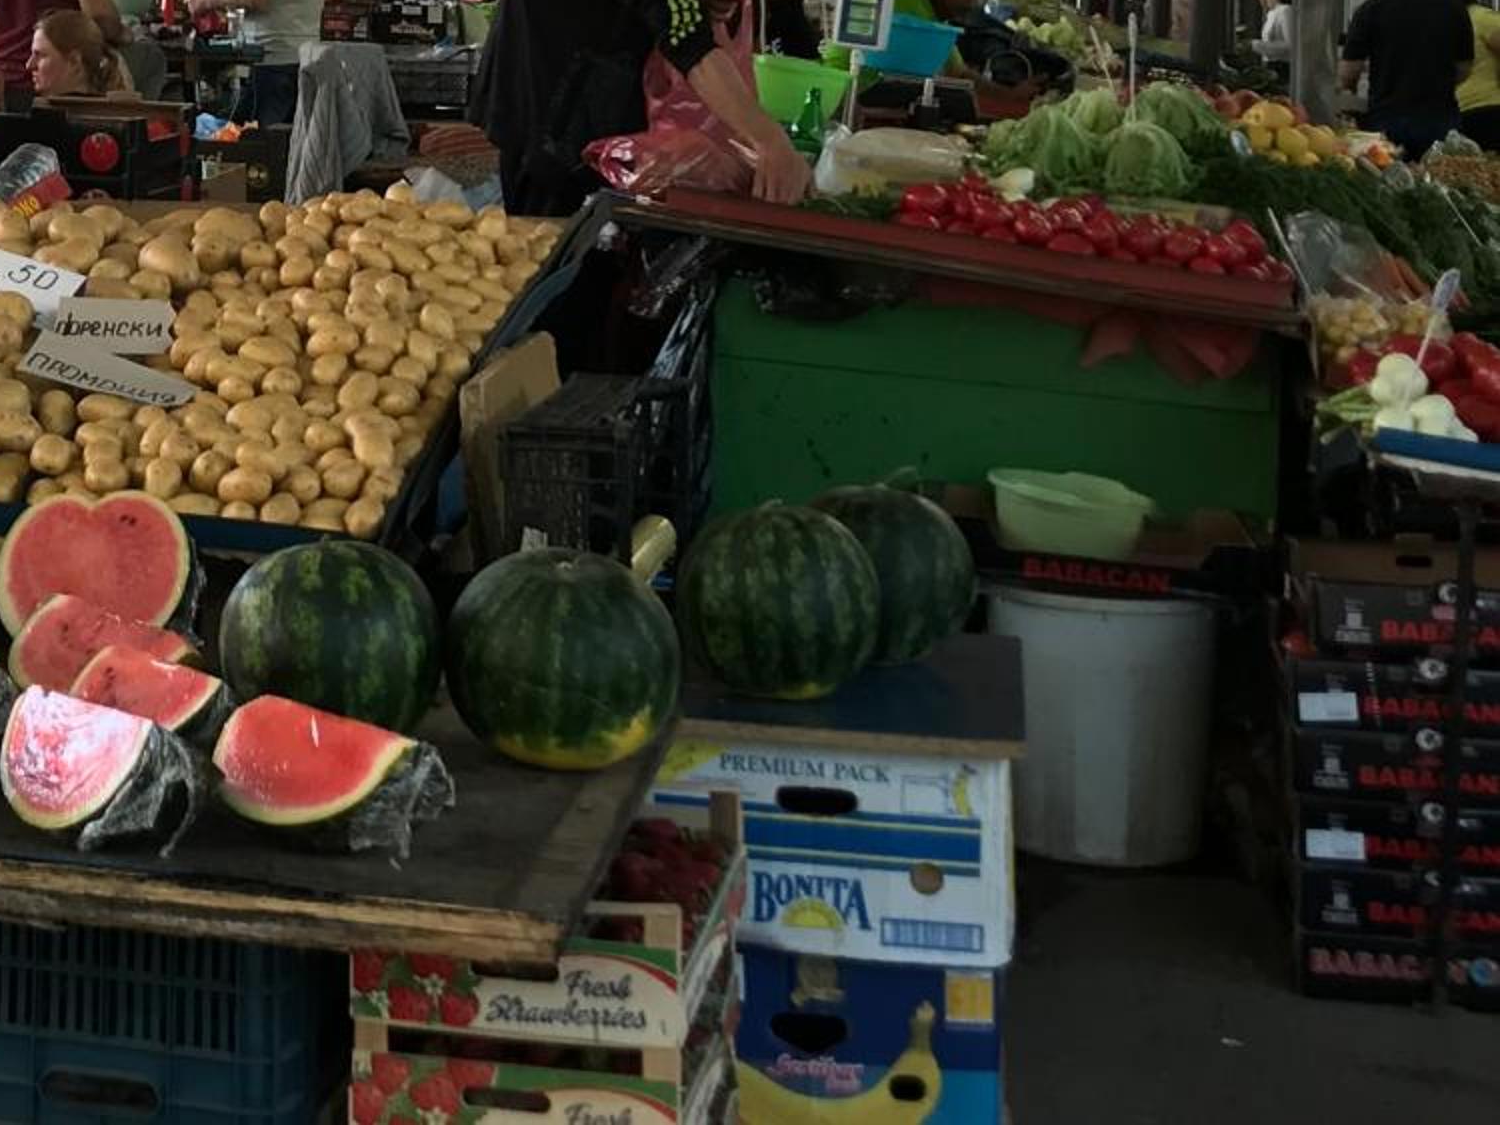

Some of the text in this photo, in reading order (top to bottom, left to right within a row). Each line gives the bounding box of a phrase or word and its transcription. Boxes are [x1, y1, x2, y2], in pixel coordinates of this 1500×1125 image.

[7, 264, 60, 290] 50
[719, 751, 891, 785] PREMIUM PACK
[752, 870, 872, 932] BONITA
[562, 969, 634, 1001] Fresh
[484, 994, 648, 1030] Strawberries
